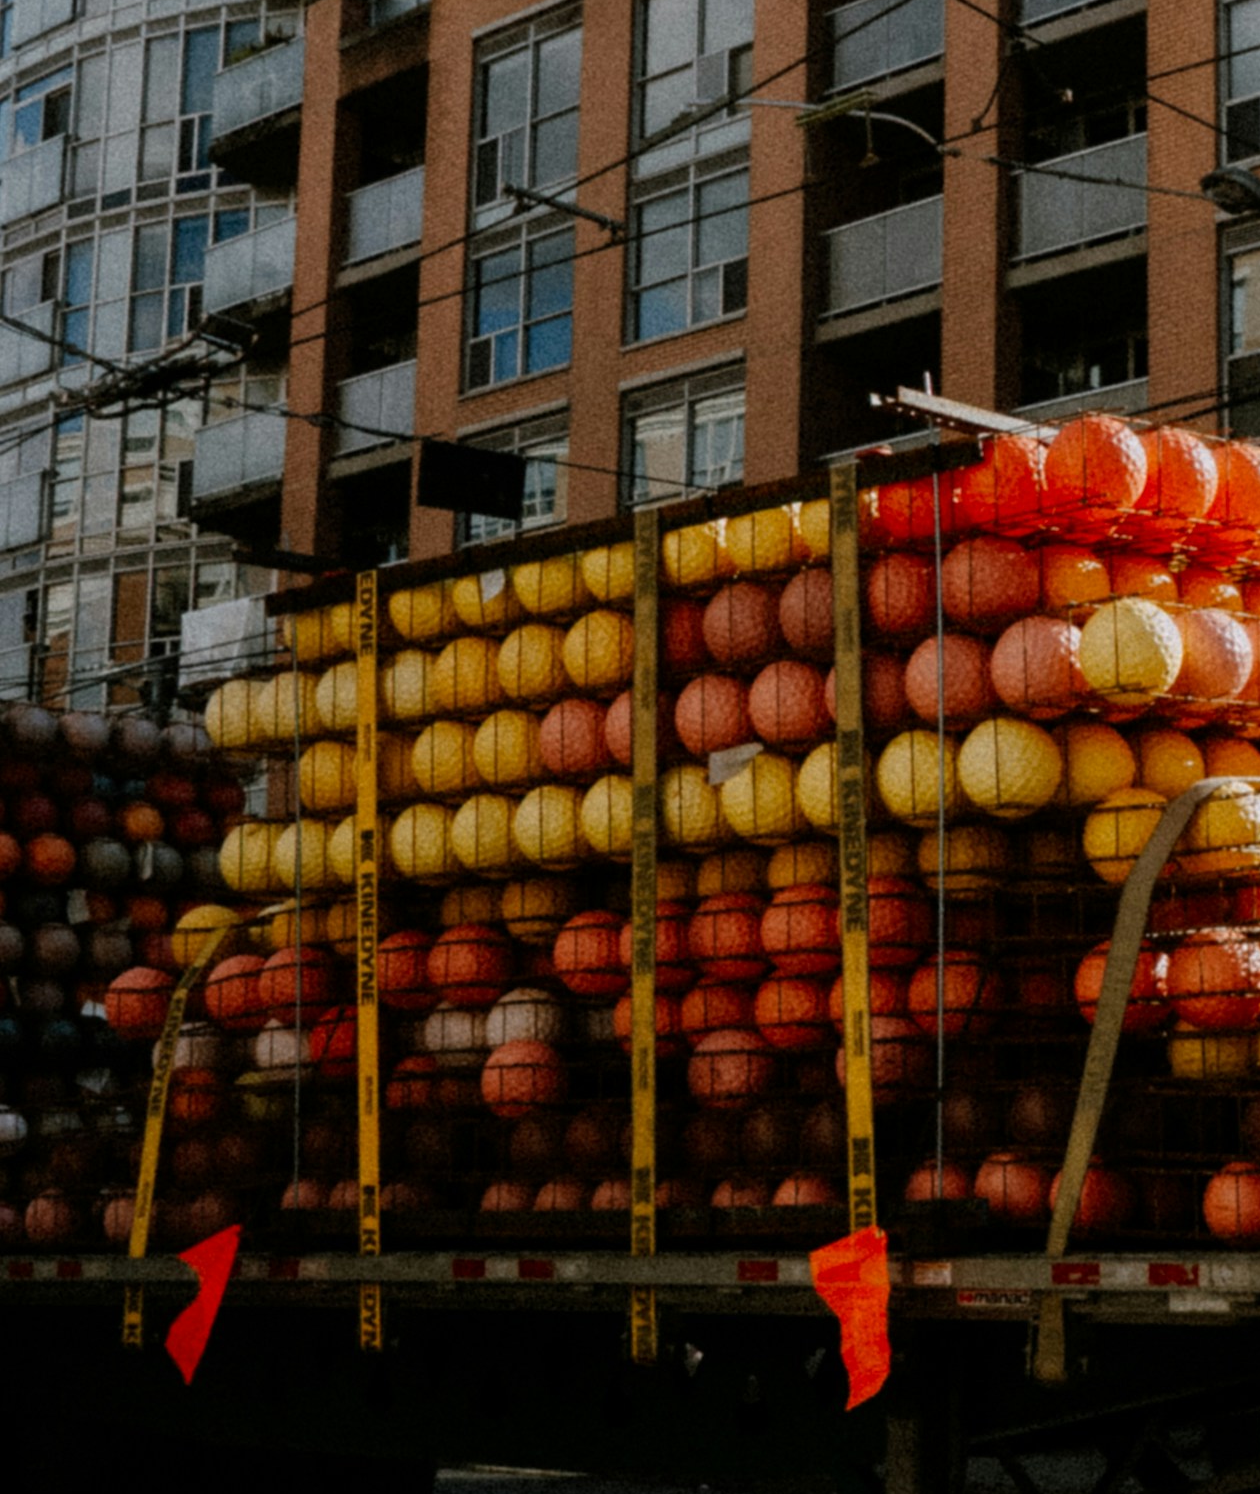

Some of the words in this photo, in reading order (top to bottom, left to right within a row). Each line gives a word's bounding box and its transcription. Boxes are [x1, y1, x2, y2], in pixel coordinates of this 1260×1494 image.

[842, 778, 866, 932] KINEDYNE
[360, 872, 376, 1006] KINEDYNE
[149, 995, 184, 1118] KINEDYNE
